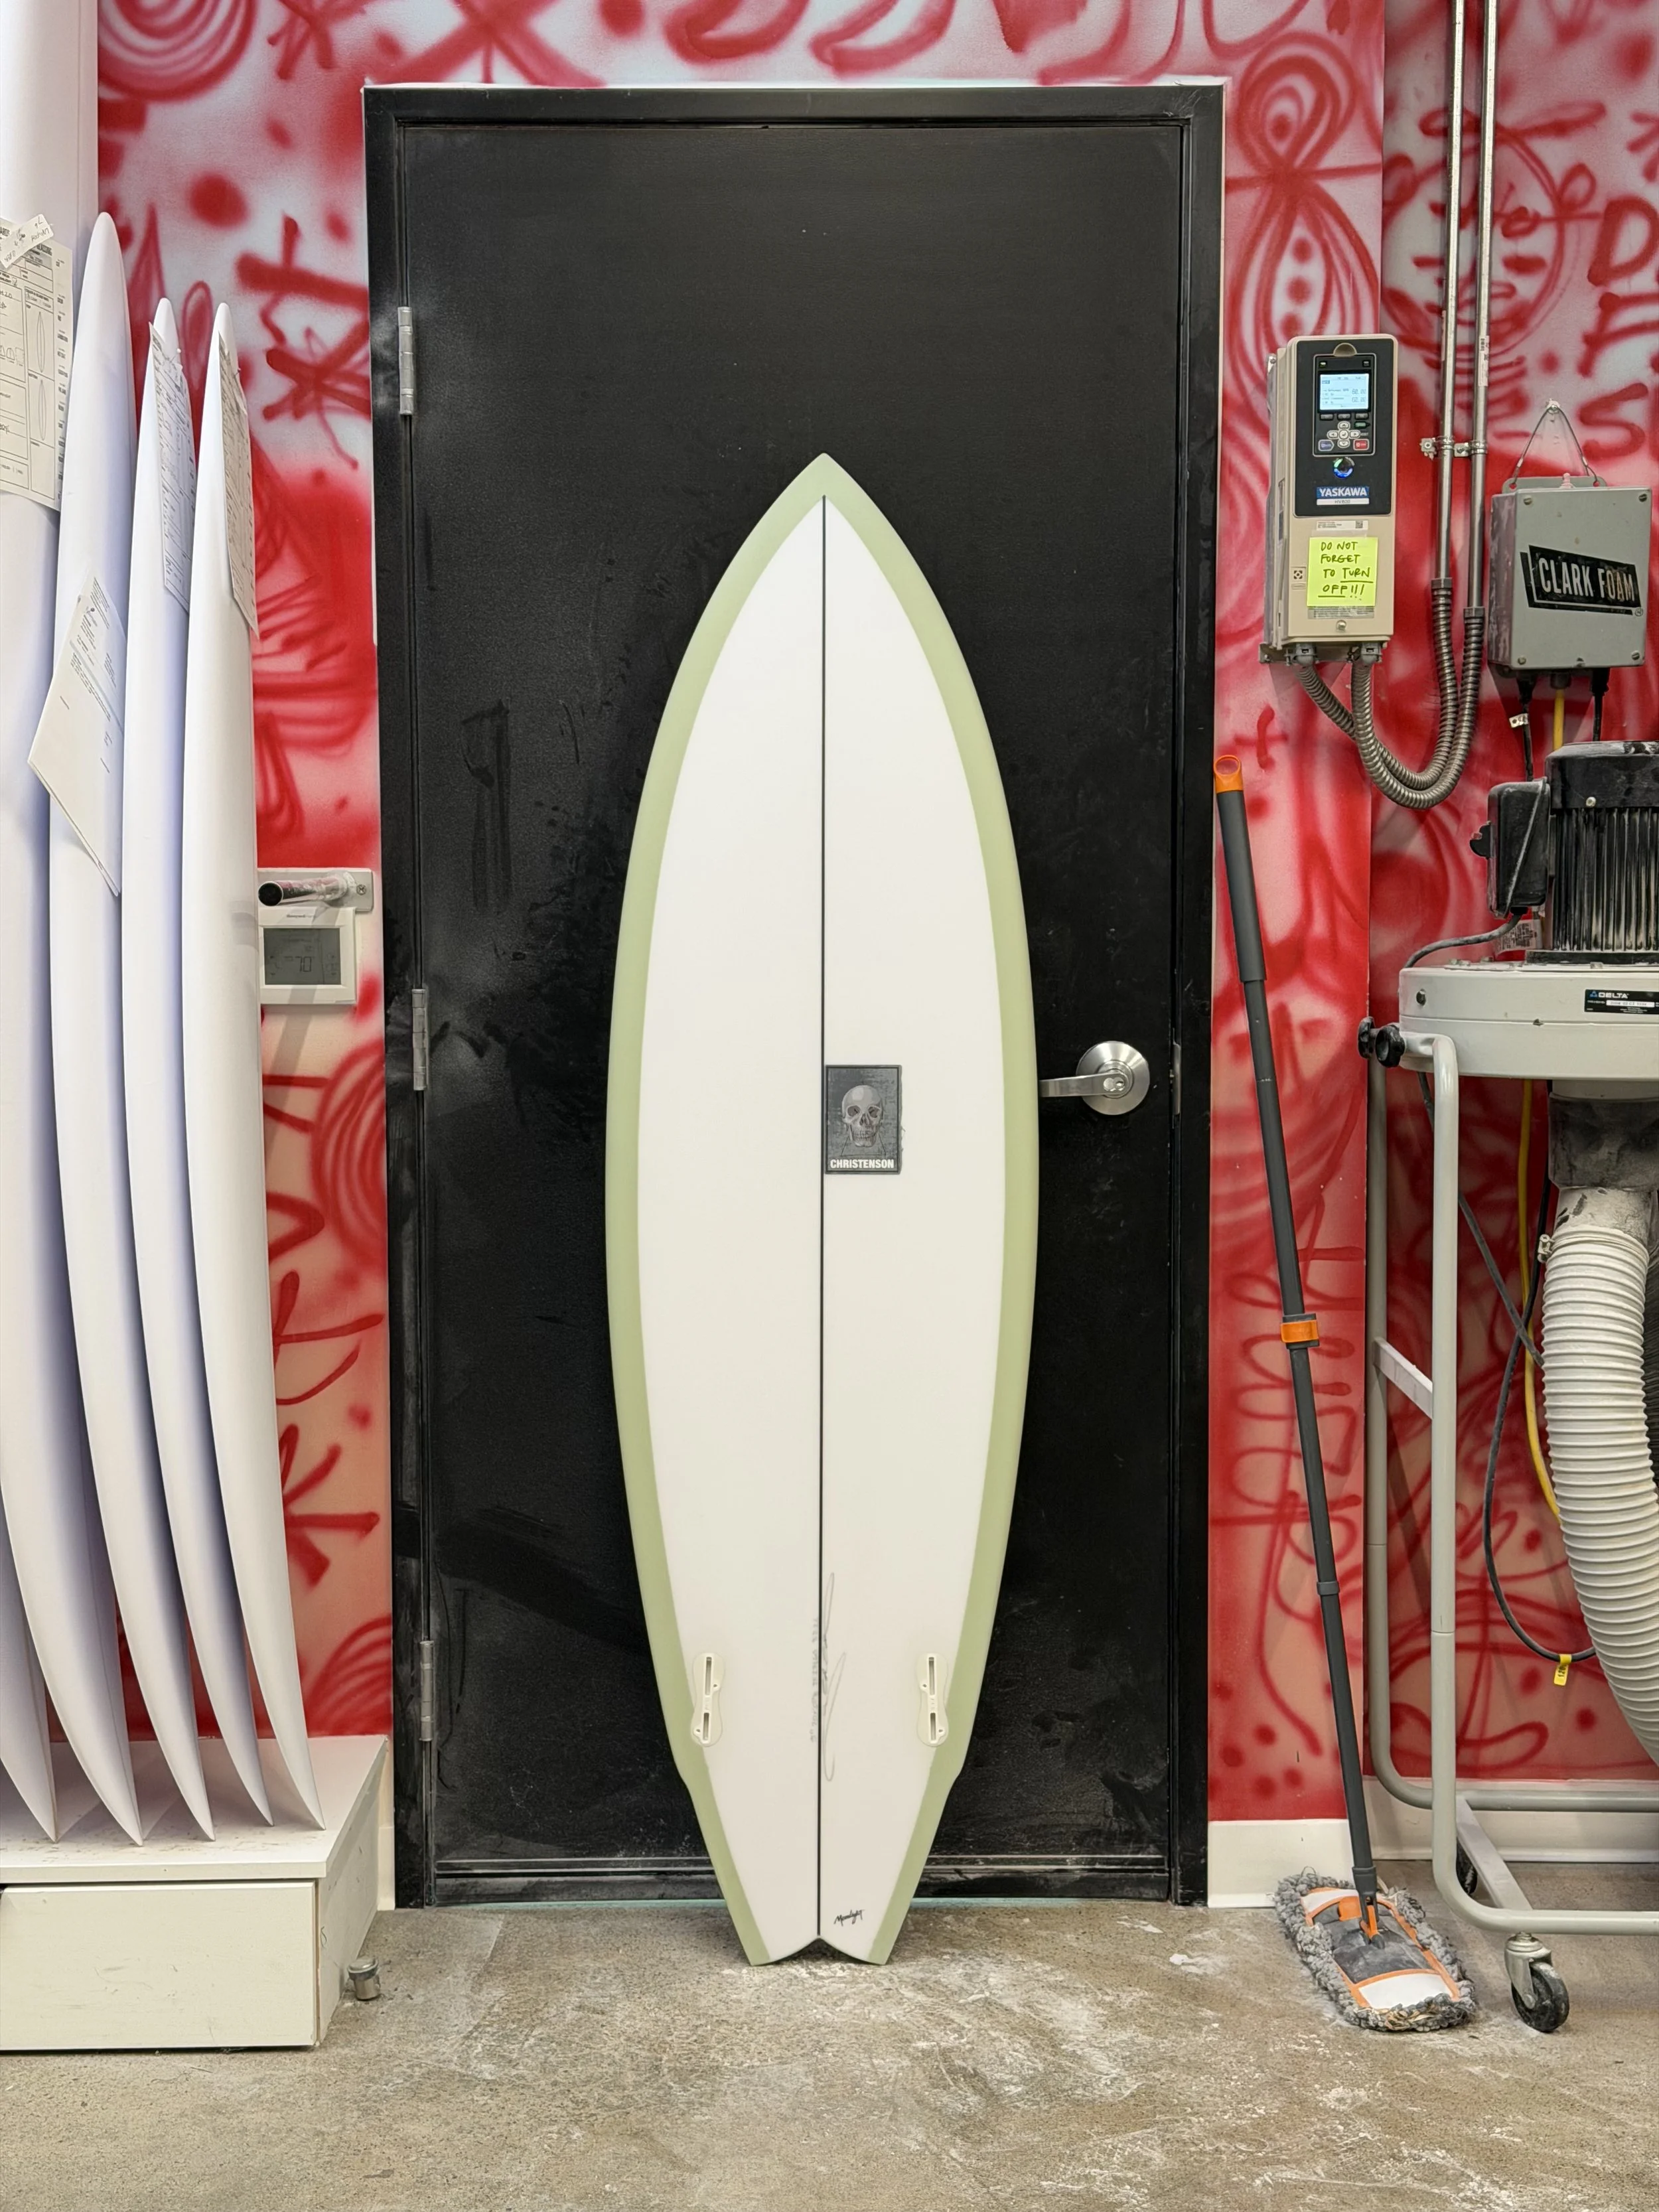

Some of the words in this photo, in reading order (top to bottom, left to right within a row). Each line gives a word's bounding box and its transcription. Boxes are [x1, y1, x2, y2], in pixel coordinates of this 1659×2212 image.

[1319, 487, 1368, 497] YASKAWA
[1321, 542, 1333, 552] DO
[1336, 542, 1358, 551] NOT
[1321, 553, 1361, 564] FORGET
[1323, 568, 1335, 579] TO
[1342, 567, 1370, 579] TURN
[1538, 557, 1594, 597] CLARK
[1597, 568, 1635, 602] FOAM
[830, 1159, 894, 1168] CHRISTENSON
